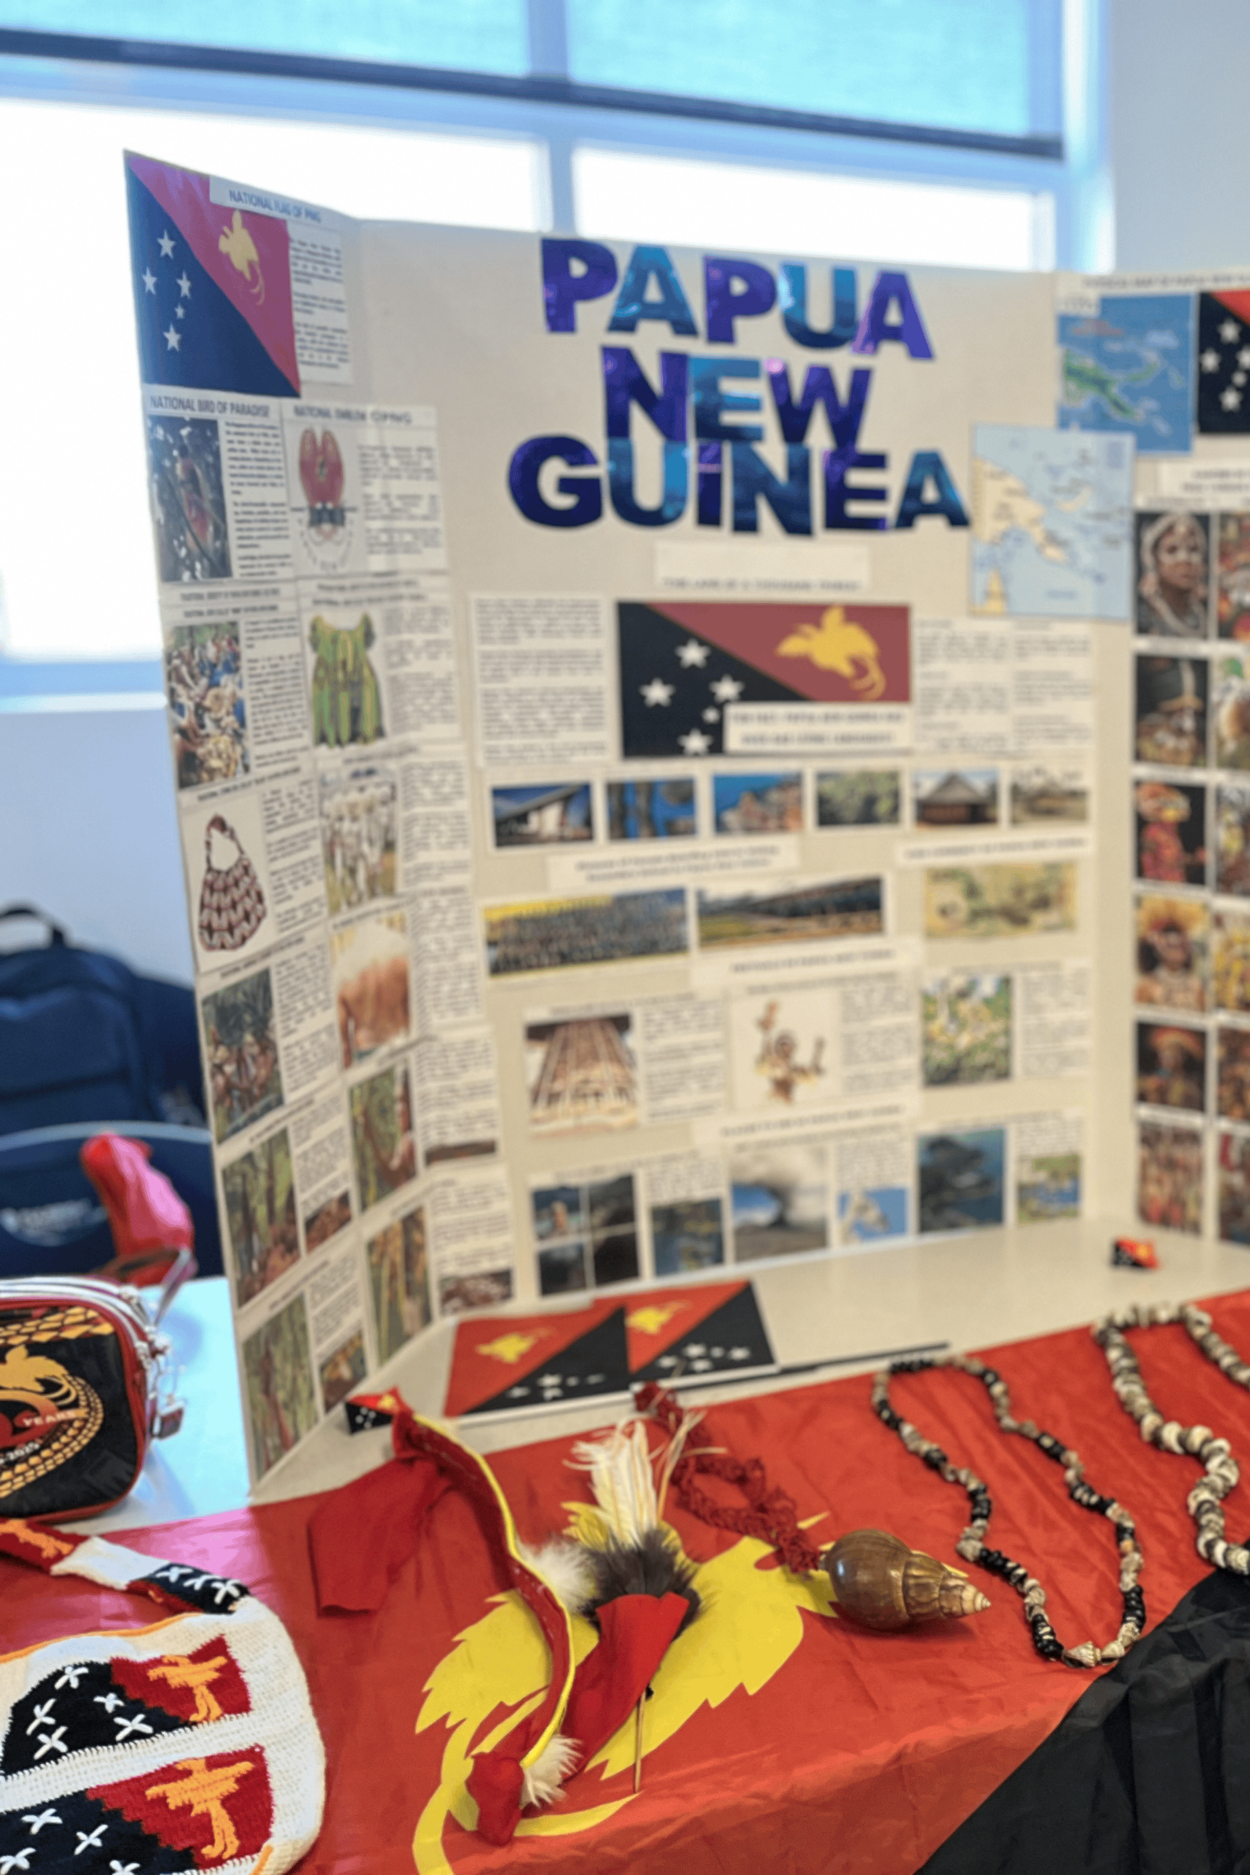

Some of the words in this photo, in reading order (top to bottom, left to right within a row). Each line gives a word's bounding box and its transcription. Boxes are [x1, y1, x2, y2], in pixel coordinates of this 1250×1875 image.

[229, 189, 273, 211] NATIONAL
[540, 237, 935, 360] PAPUA
[150, 395, 196, 412] NATIONAL
[600, 344, 874, 450] NEW
[508, 434, 971, 536] GUINEA
